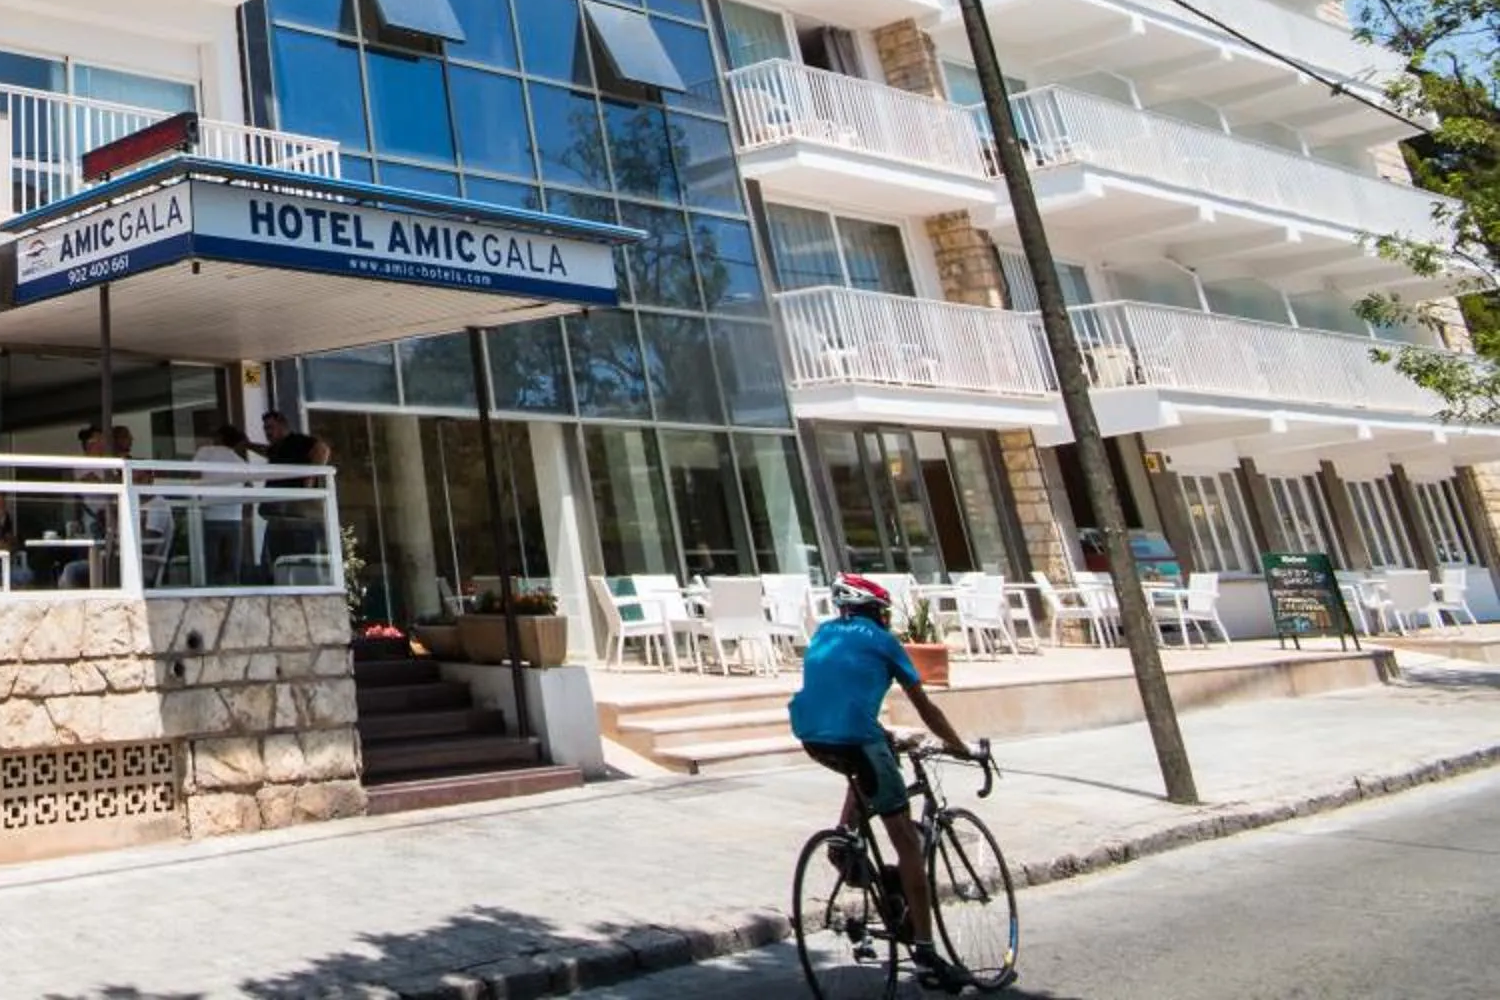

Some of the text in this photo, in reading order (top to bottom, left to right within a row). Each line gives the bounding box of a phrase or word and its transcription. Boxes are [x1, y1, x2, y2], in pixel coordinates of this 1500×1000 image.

[250, 199, 375, 250] HOTEL
[67, 264, 87, 286] 902
[90, 258, 110, 278] 400
[111, 253, 130, 272] 661
[350, 258, 493, 286] www.amic-hotels.com
